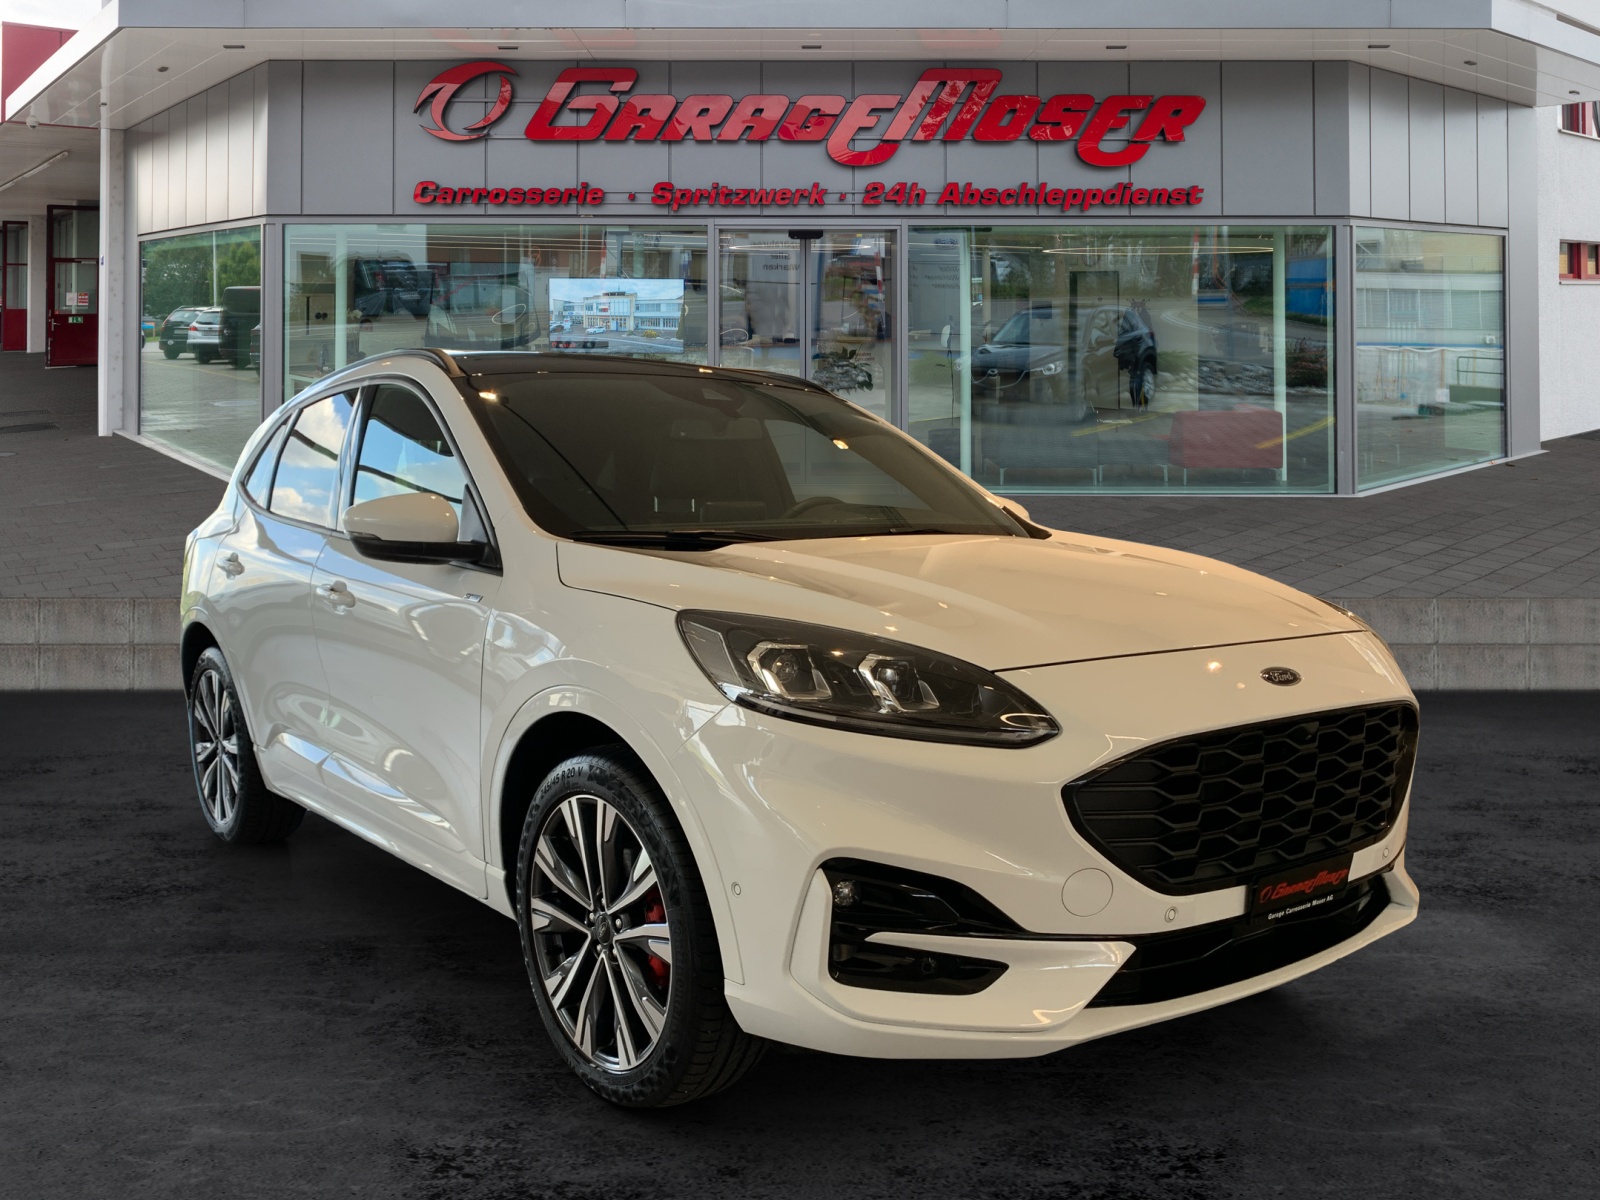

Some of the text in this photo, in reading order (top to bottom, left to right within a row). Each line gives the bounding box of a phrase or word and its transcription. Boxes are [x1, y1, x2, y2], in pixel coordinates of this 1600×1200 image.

[414, 181, 1203, 211] Carrosserie Spritzwerk 24h Abschleppdienst
[1326, 894, 1334, 902] AG
